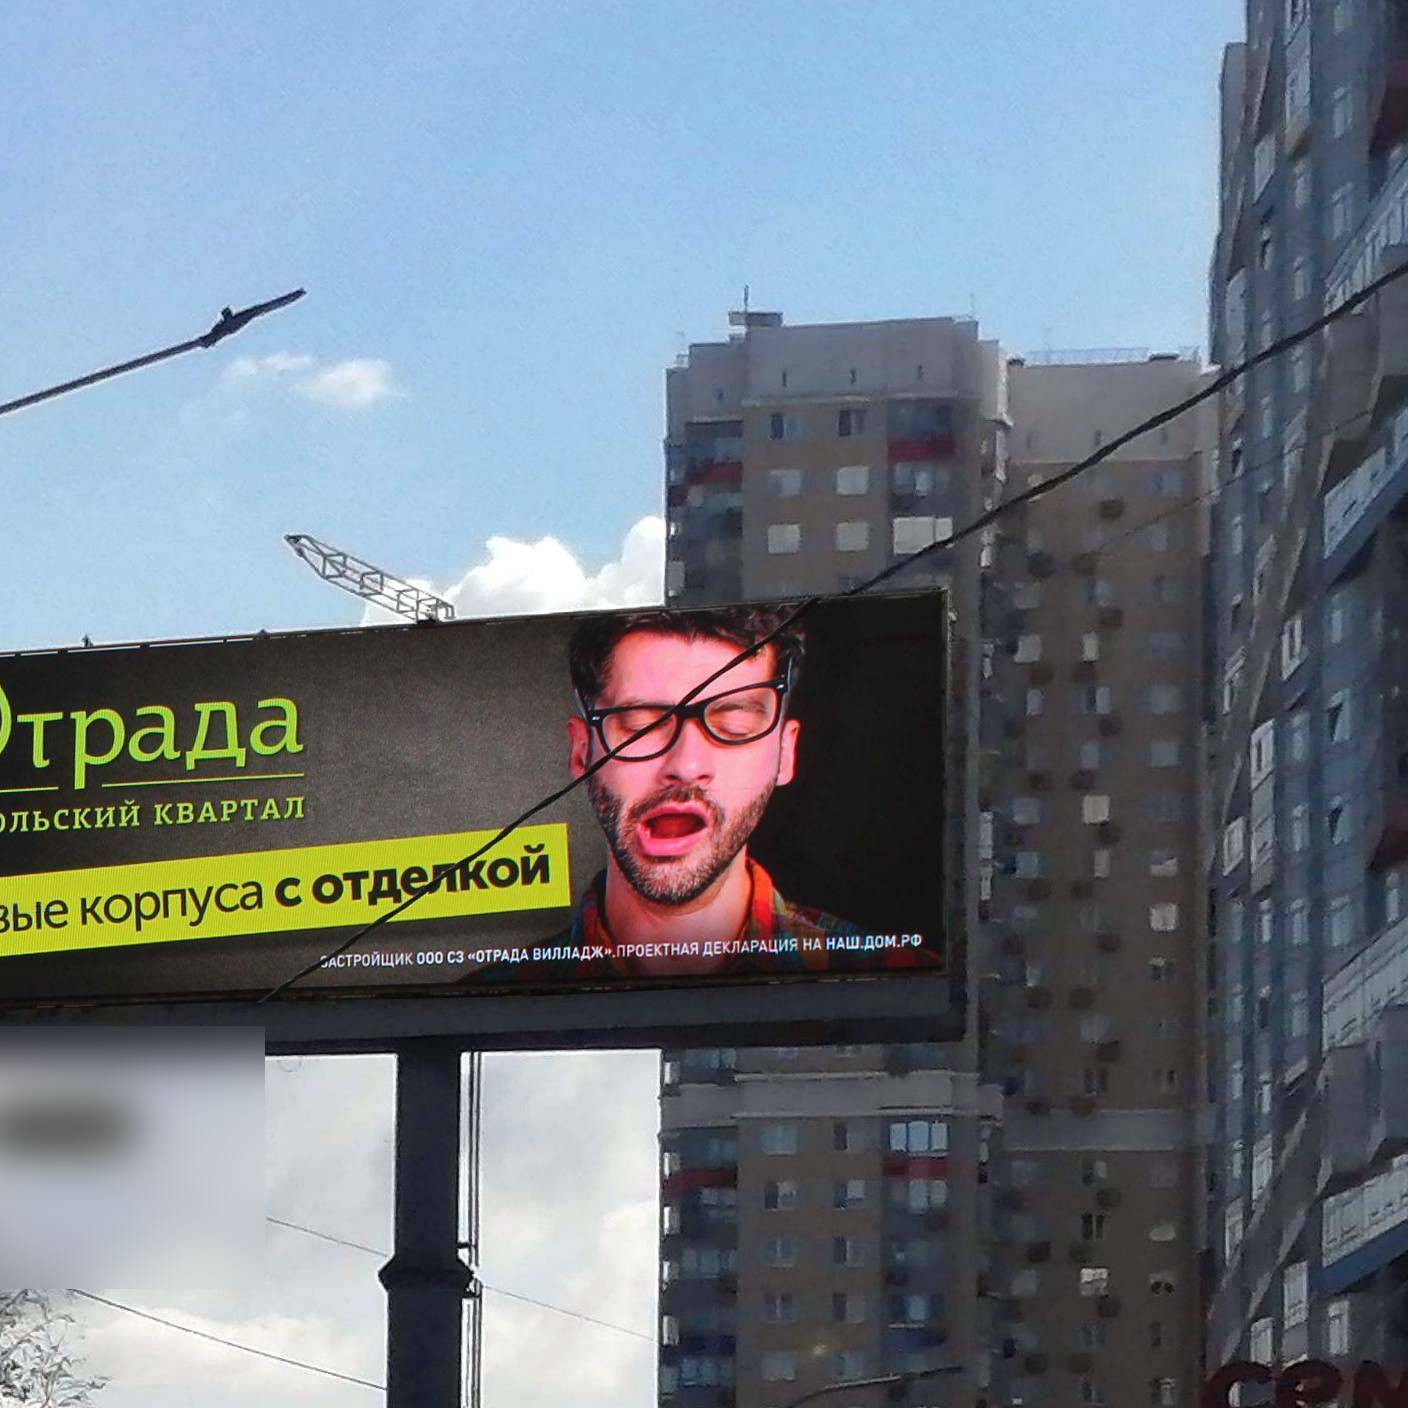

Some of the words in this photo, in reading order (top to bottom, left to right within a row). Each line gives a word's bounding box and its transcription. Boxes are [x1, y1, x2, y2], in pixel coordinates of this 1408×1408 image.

[153, 796, 306, 827] КВАРТАЛ
[80, 876, 263, 936] корпуса
[274, 876, 302, 908] с
[312, 844, 551, 907] отделкой
[416, 951, 446, 966] ООО
[447, 951, 465, 965] СЗ
[467, 949, 529, 964] «ОТРАДА
[702, 938, 798, 957] ДЕКЛАРАЦИЯ
[802, 937, 823, 951] НА
[826, 933, 923, 951] НАШ.ДОМ.РФ
